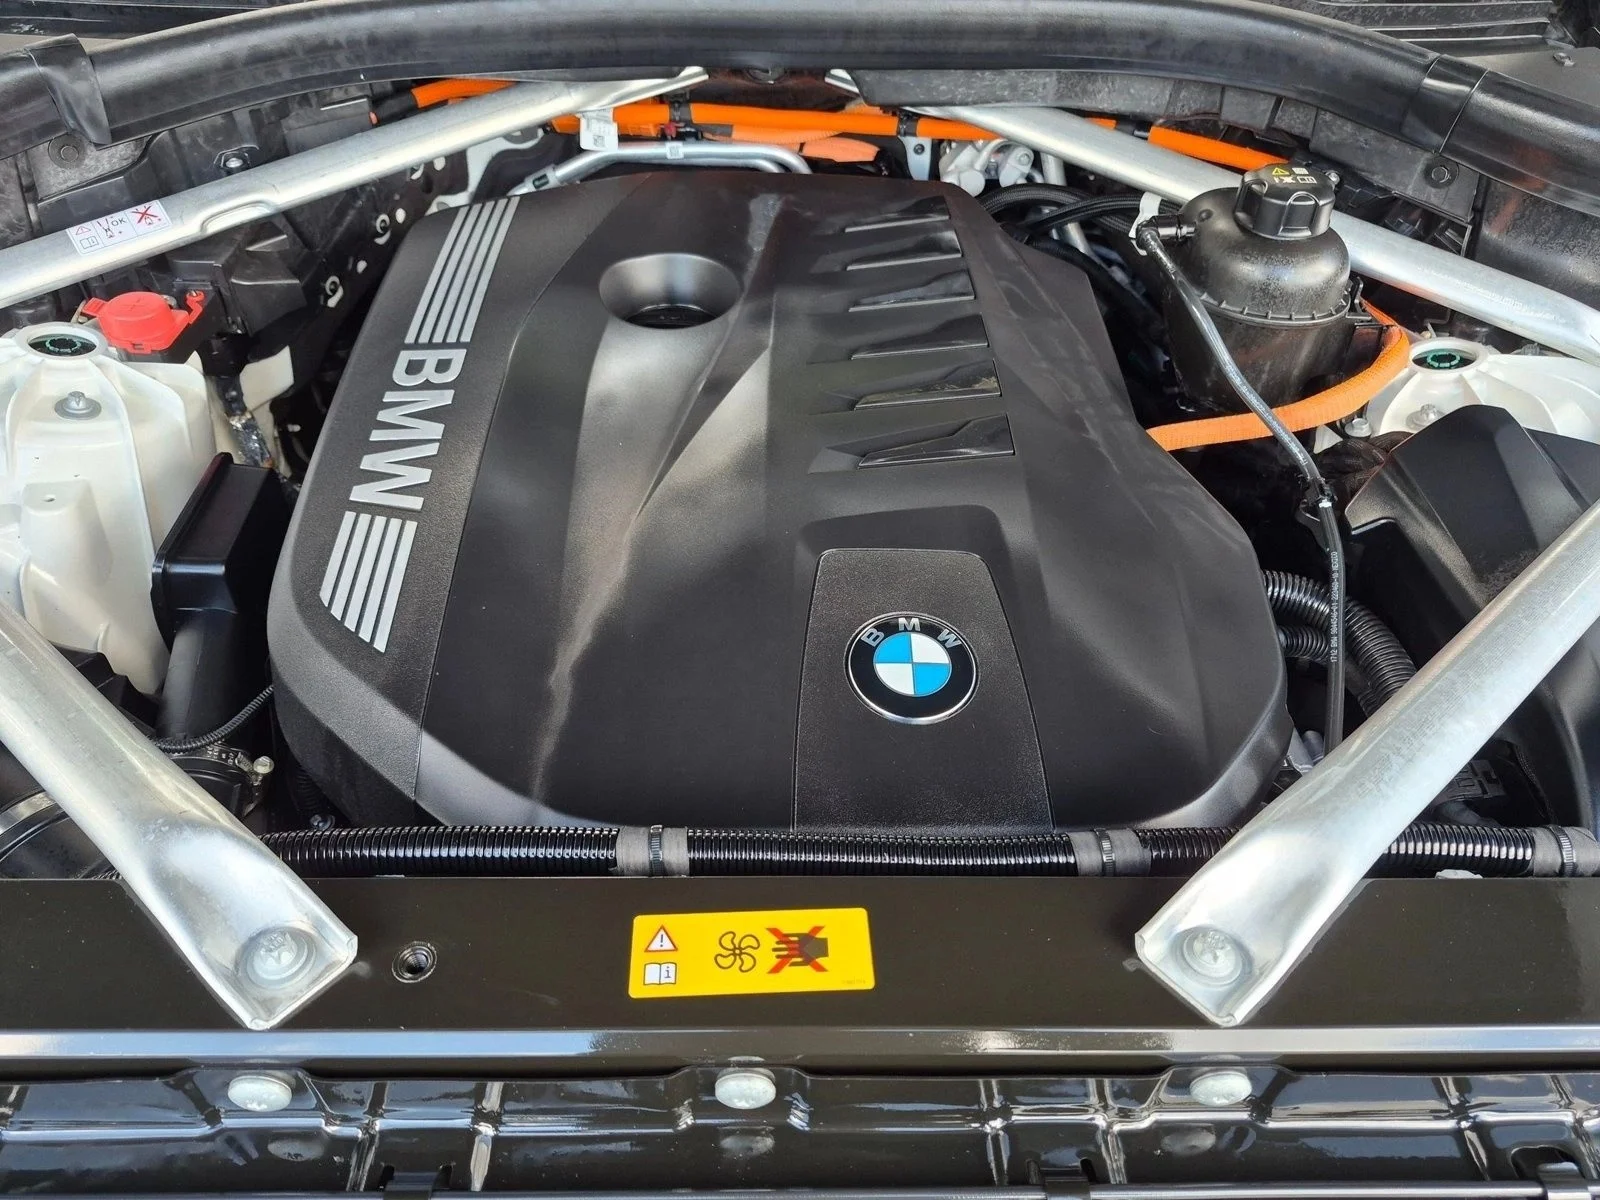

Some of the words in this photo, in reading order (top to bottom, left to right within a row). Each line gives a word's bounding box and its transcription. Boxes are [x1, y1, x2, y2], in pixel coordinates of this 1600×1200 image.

[111, 217, 127, 227] OK
[349, 349, 467, 512] BMW
[860, 616, 962, 649] BMW
[1330, 636, 1338, 648] BMW
